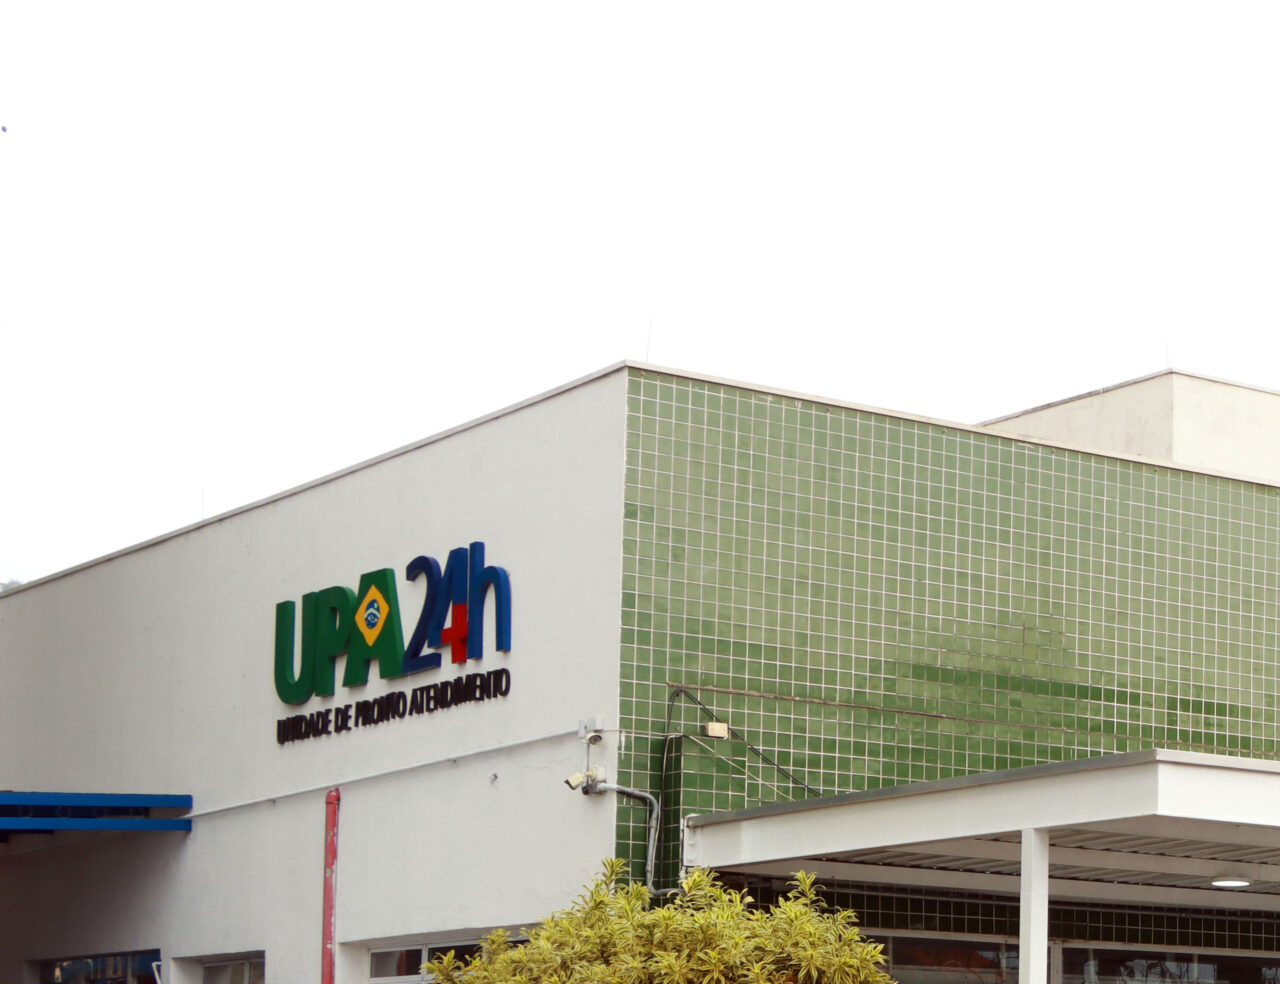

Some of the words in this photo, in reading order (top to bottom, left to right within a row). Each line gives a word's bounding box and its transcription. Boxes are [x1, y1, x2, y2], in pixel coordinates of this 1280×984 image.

[274, 568, 405, 705] UPA
[402, 541, 512, 675] 24h
[277, 708, 333, 746] UNIDADE
[334, 704, 353, 733] DE
[354, 691, 408, 728] PRONTO
[409, 668, 512, 717] ATENDIMENTO
